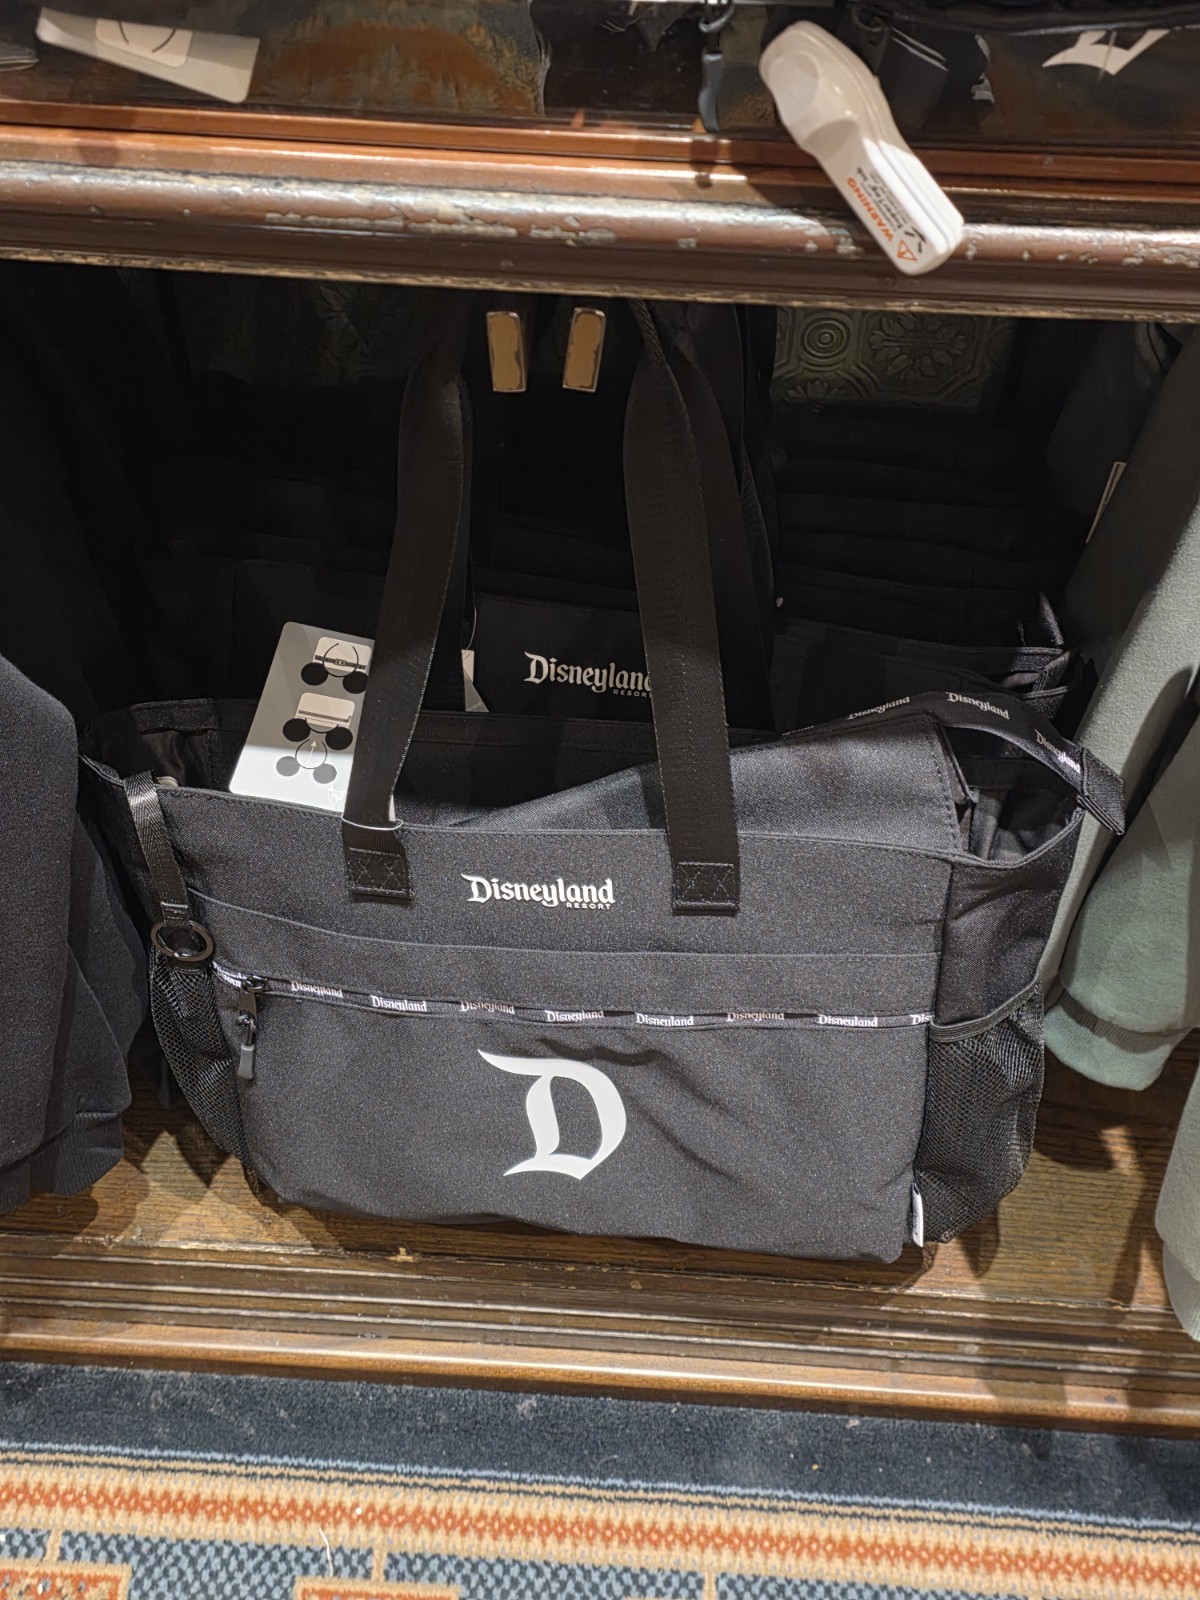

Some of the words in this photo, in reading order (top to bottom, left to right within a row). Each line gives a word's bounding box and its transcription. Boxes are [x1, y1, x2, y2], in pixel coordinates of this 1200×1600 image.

[847, 177, 894, 241] WARNING
[846, 696, 910, 720] Disneyland
[945, 692, 1010, 720] Disneyland
[1035, 729, 1081, 774] Disneyland
[460, 873, 616, 907] Disneyland
[566, 902, 612, 910] RESORT
[290, 980, 344, 998] Disneyland
[370, 995, 428, 1013] Disneyland
[545, 1009, 605, 1023] Disneyland
[636, 1013, 694, 1027] Disneyland
[818, 1014, 878, 1028] Disneyland
[477, 1049, 627, 1180] D
